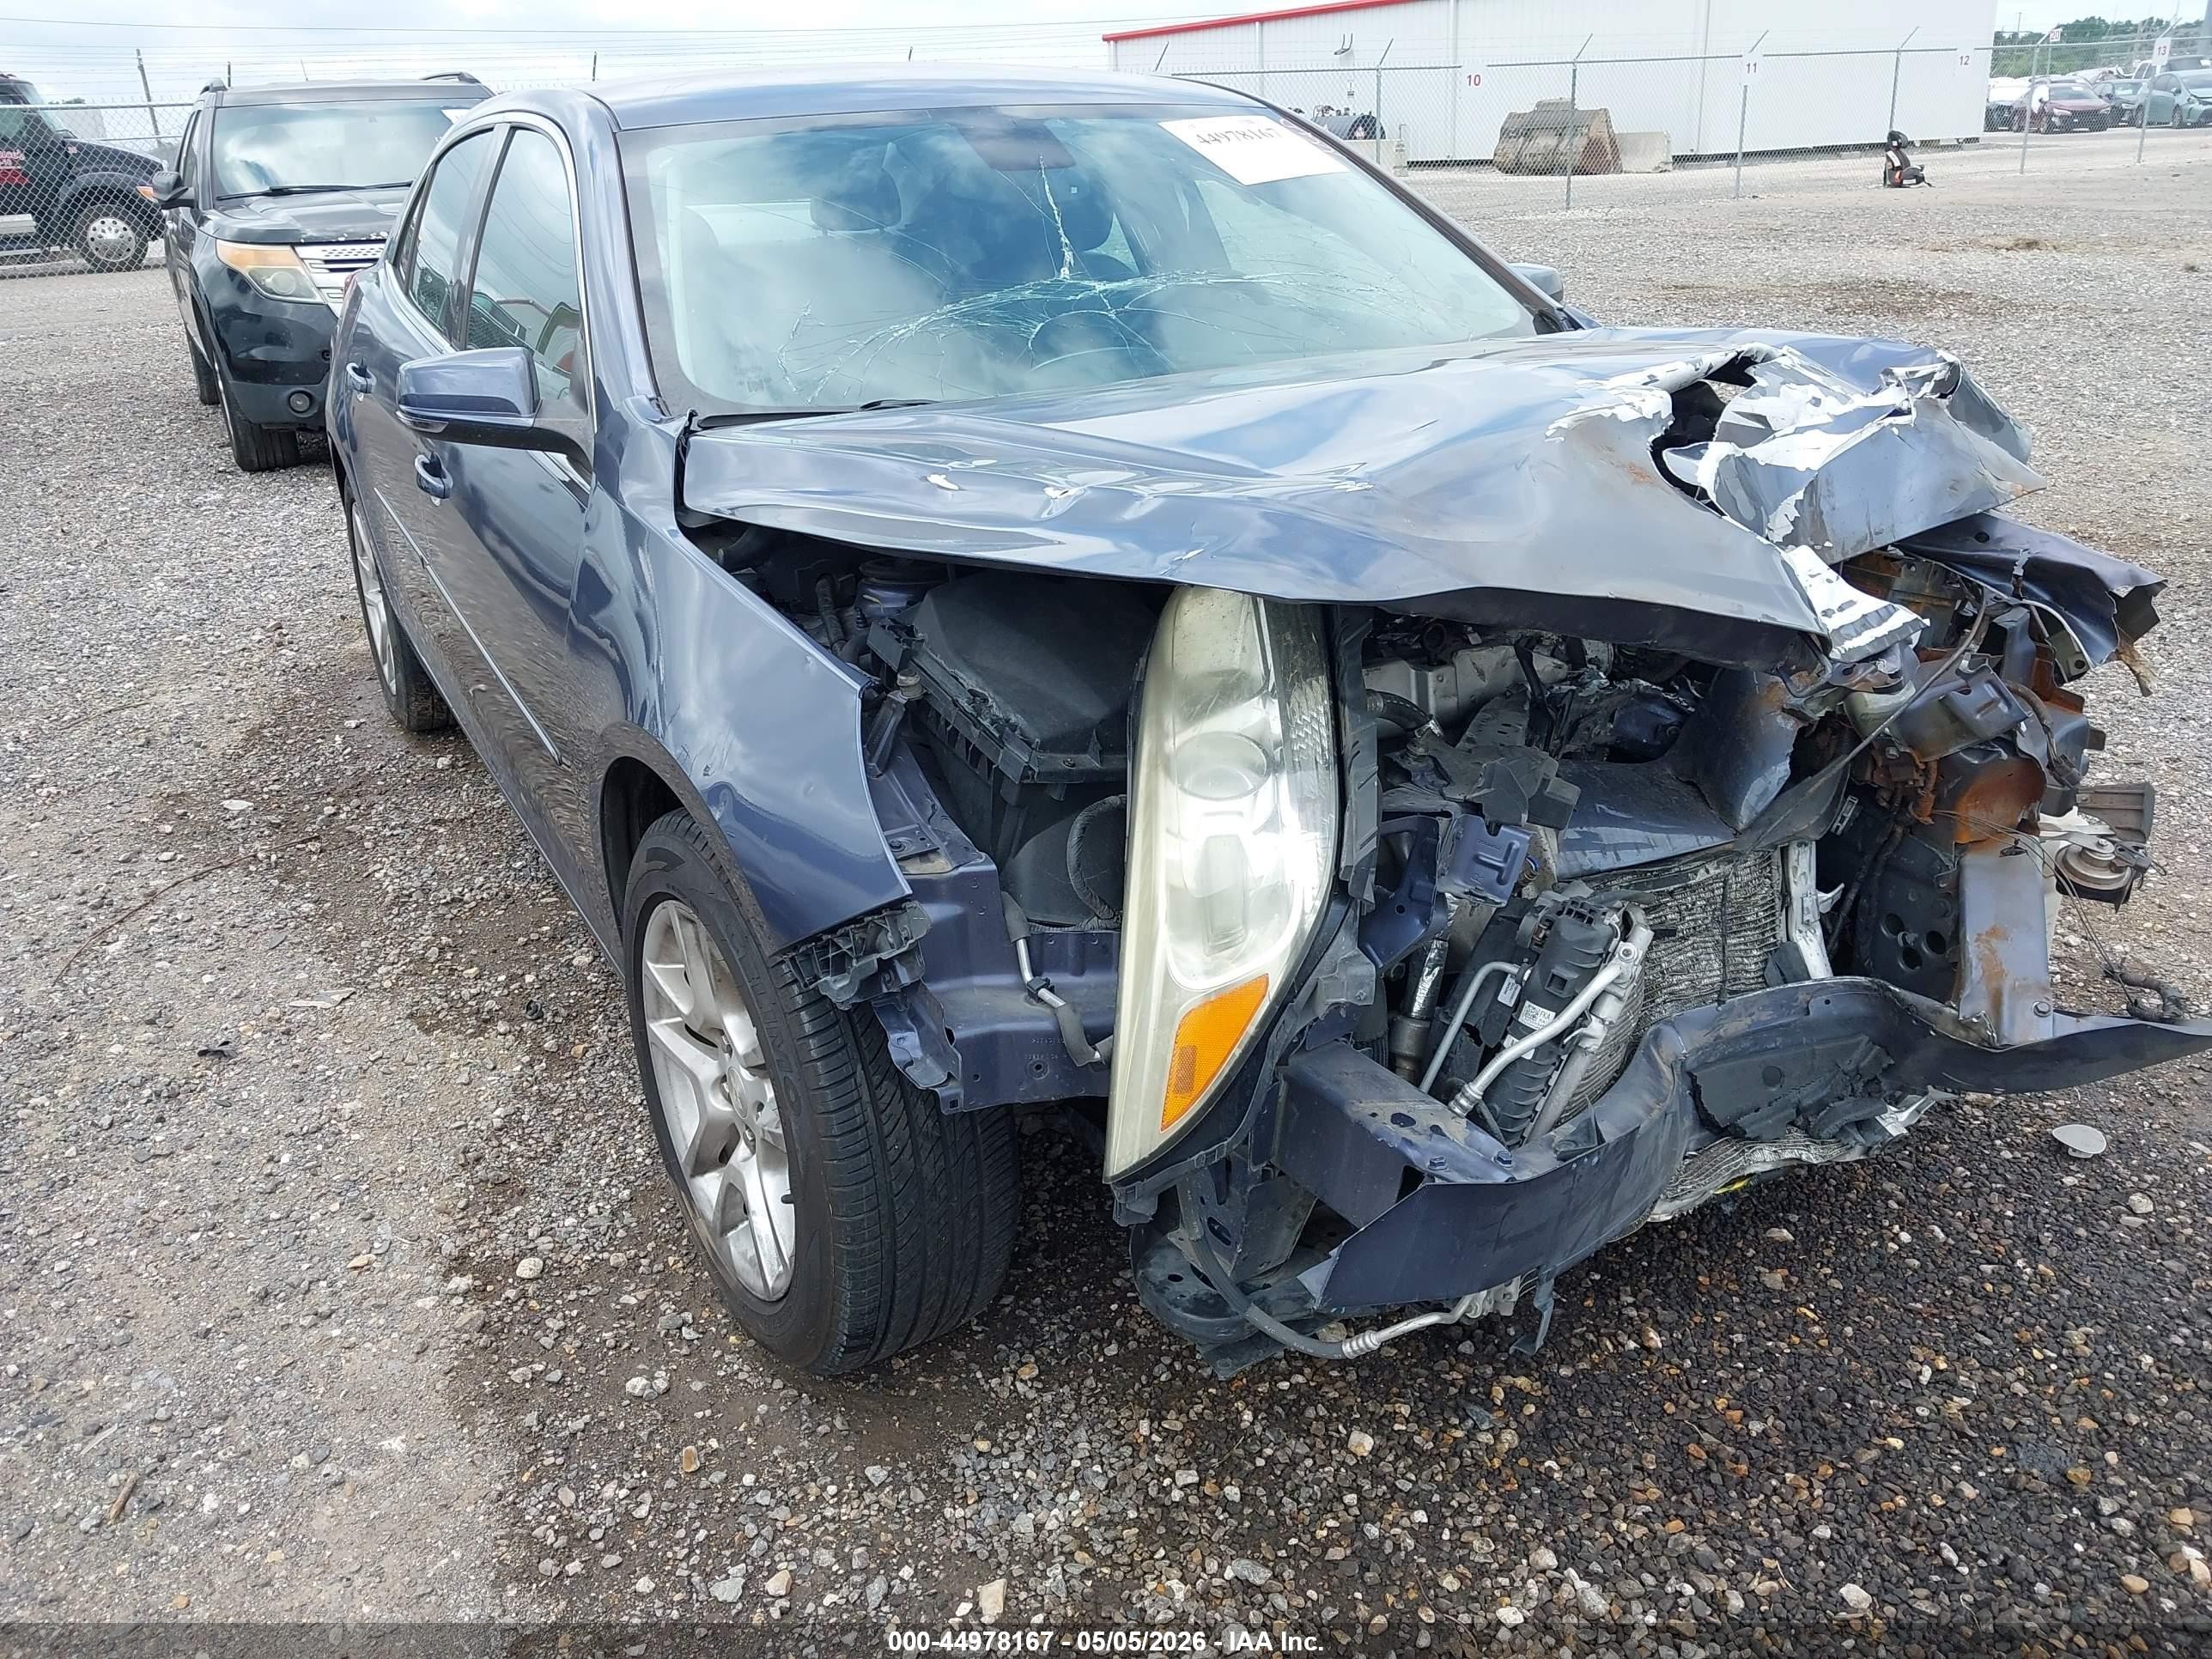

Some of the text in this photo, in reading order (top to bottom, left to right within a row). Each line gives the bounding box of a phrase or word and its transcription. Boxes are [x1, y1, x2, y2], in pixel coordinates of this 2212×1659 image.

[2051, 30, 2060, 40] 20
[2157, 46, 2167, 56] 13
[1960, 55, 1970, 66] 12
[1746, 62, 1757, 74] 11
[1467, 74, 1481, 87] 10
[1196, 127, 1281, 145] 44978167
